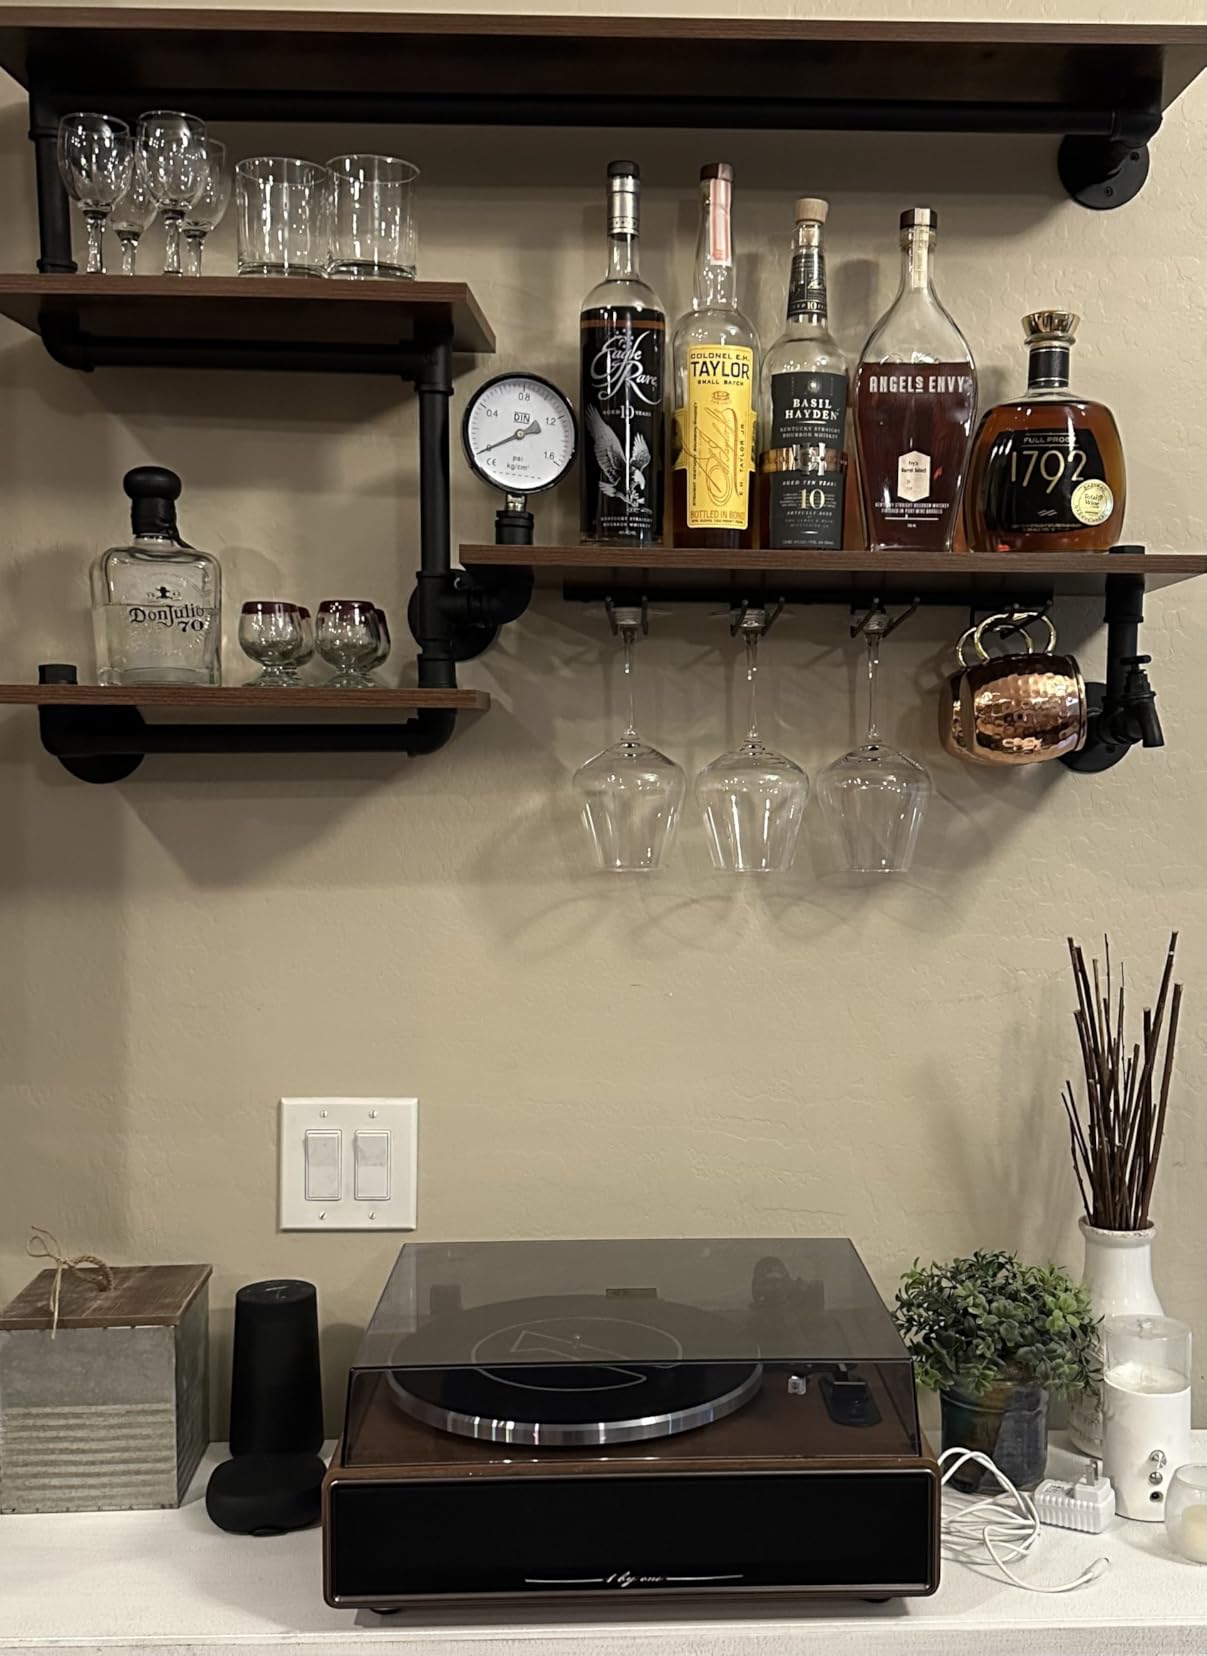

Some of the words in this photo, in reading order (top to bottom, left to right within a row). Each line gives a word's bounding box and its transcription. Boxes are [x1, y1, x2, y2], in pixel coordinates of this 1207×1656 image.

[690, 360, 750, 380] TAYLOR
[928, 376, 965, 393] ENVY
[792, 398, 832, 409] BASIL
[486, 408, 498, 418] 0.4
[513, 412, 531, 423] DIN
[620, 405, 635, 419] 10
[785, 409, 838, 420] HAYDEN
[1010, 450, 1088, 494] 1792
[801, 488, 825, 510] 10
[690, 510, 719, 519] BOTTLED
[720, 511, 728, 519] IN
[177, 619, 204, 632] 70
